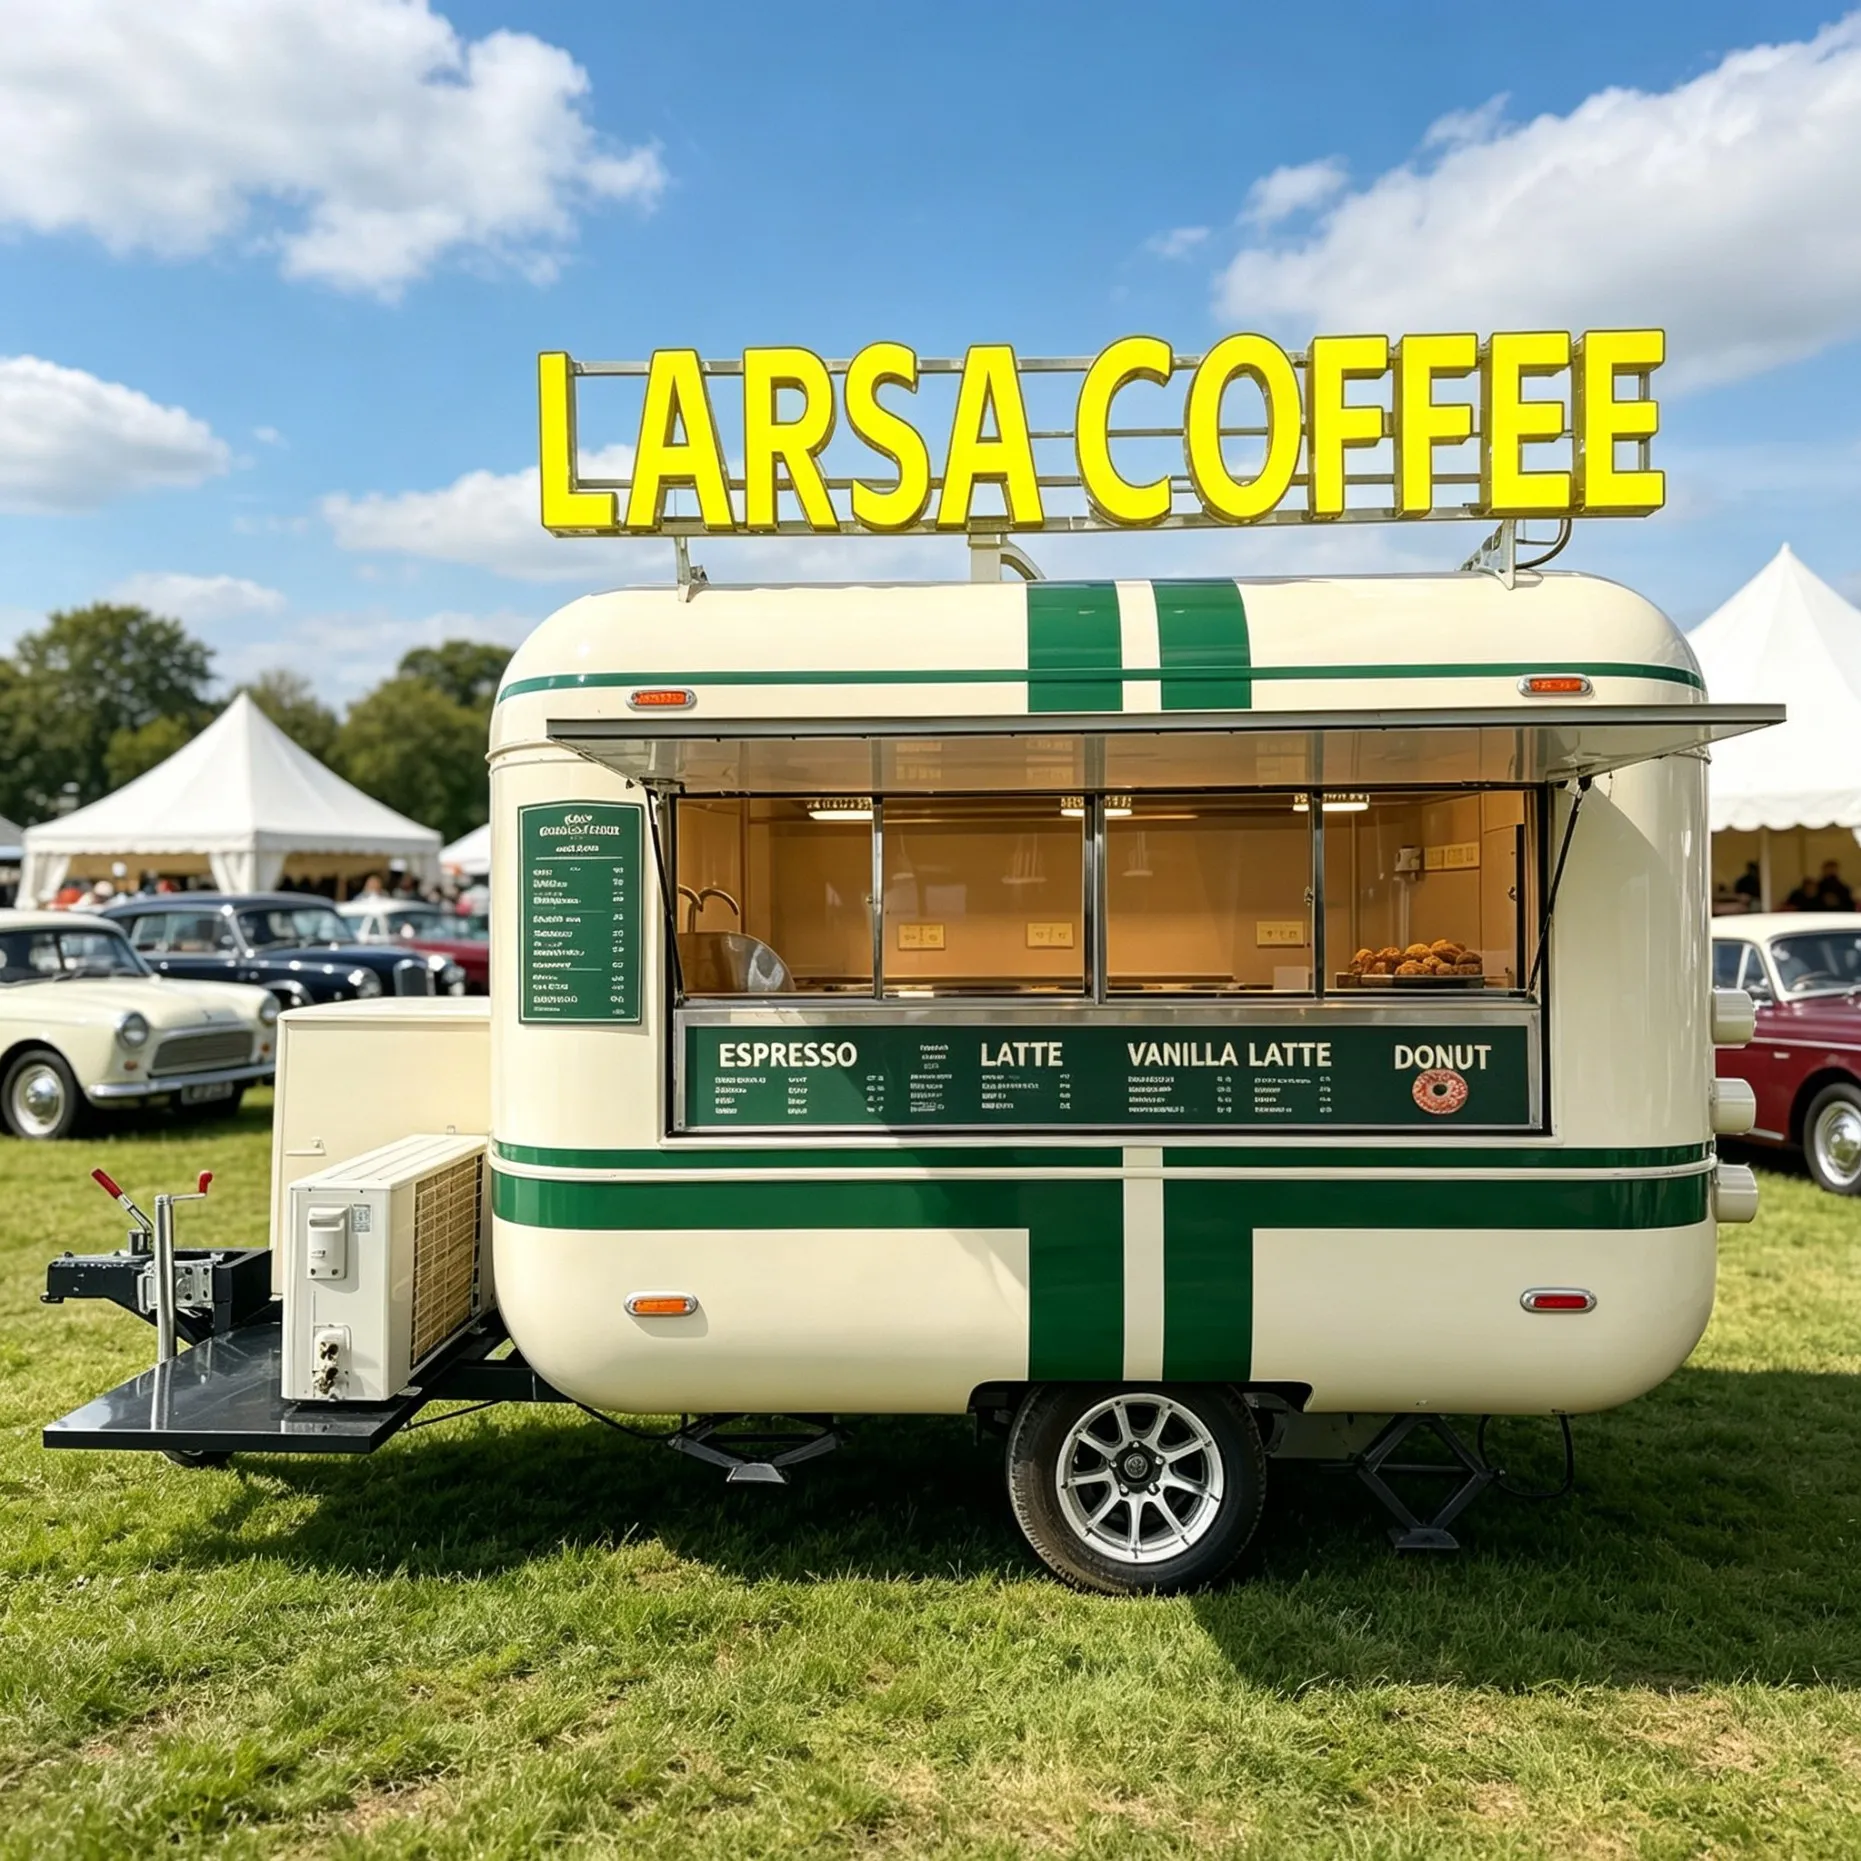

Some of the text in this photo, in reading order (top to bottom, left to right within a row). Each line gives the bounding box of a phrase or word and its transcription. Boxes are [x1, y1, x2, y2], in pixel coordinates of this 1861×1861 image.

[539, 330, 1664, 532] LARSA COFFEE
[720, 1042, 857, 1067] ESPRESSO
[981, 1042, 1063, 1066] LATTE
[1128, 1043, 1331, 1066] VANILLA LATTE
[1395, 1045, 1491, 1069] DONUT
